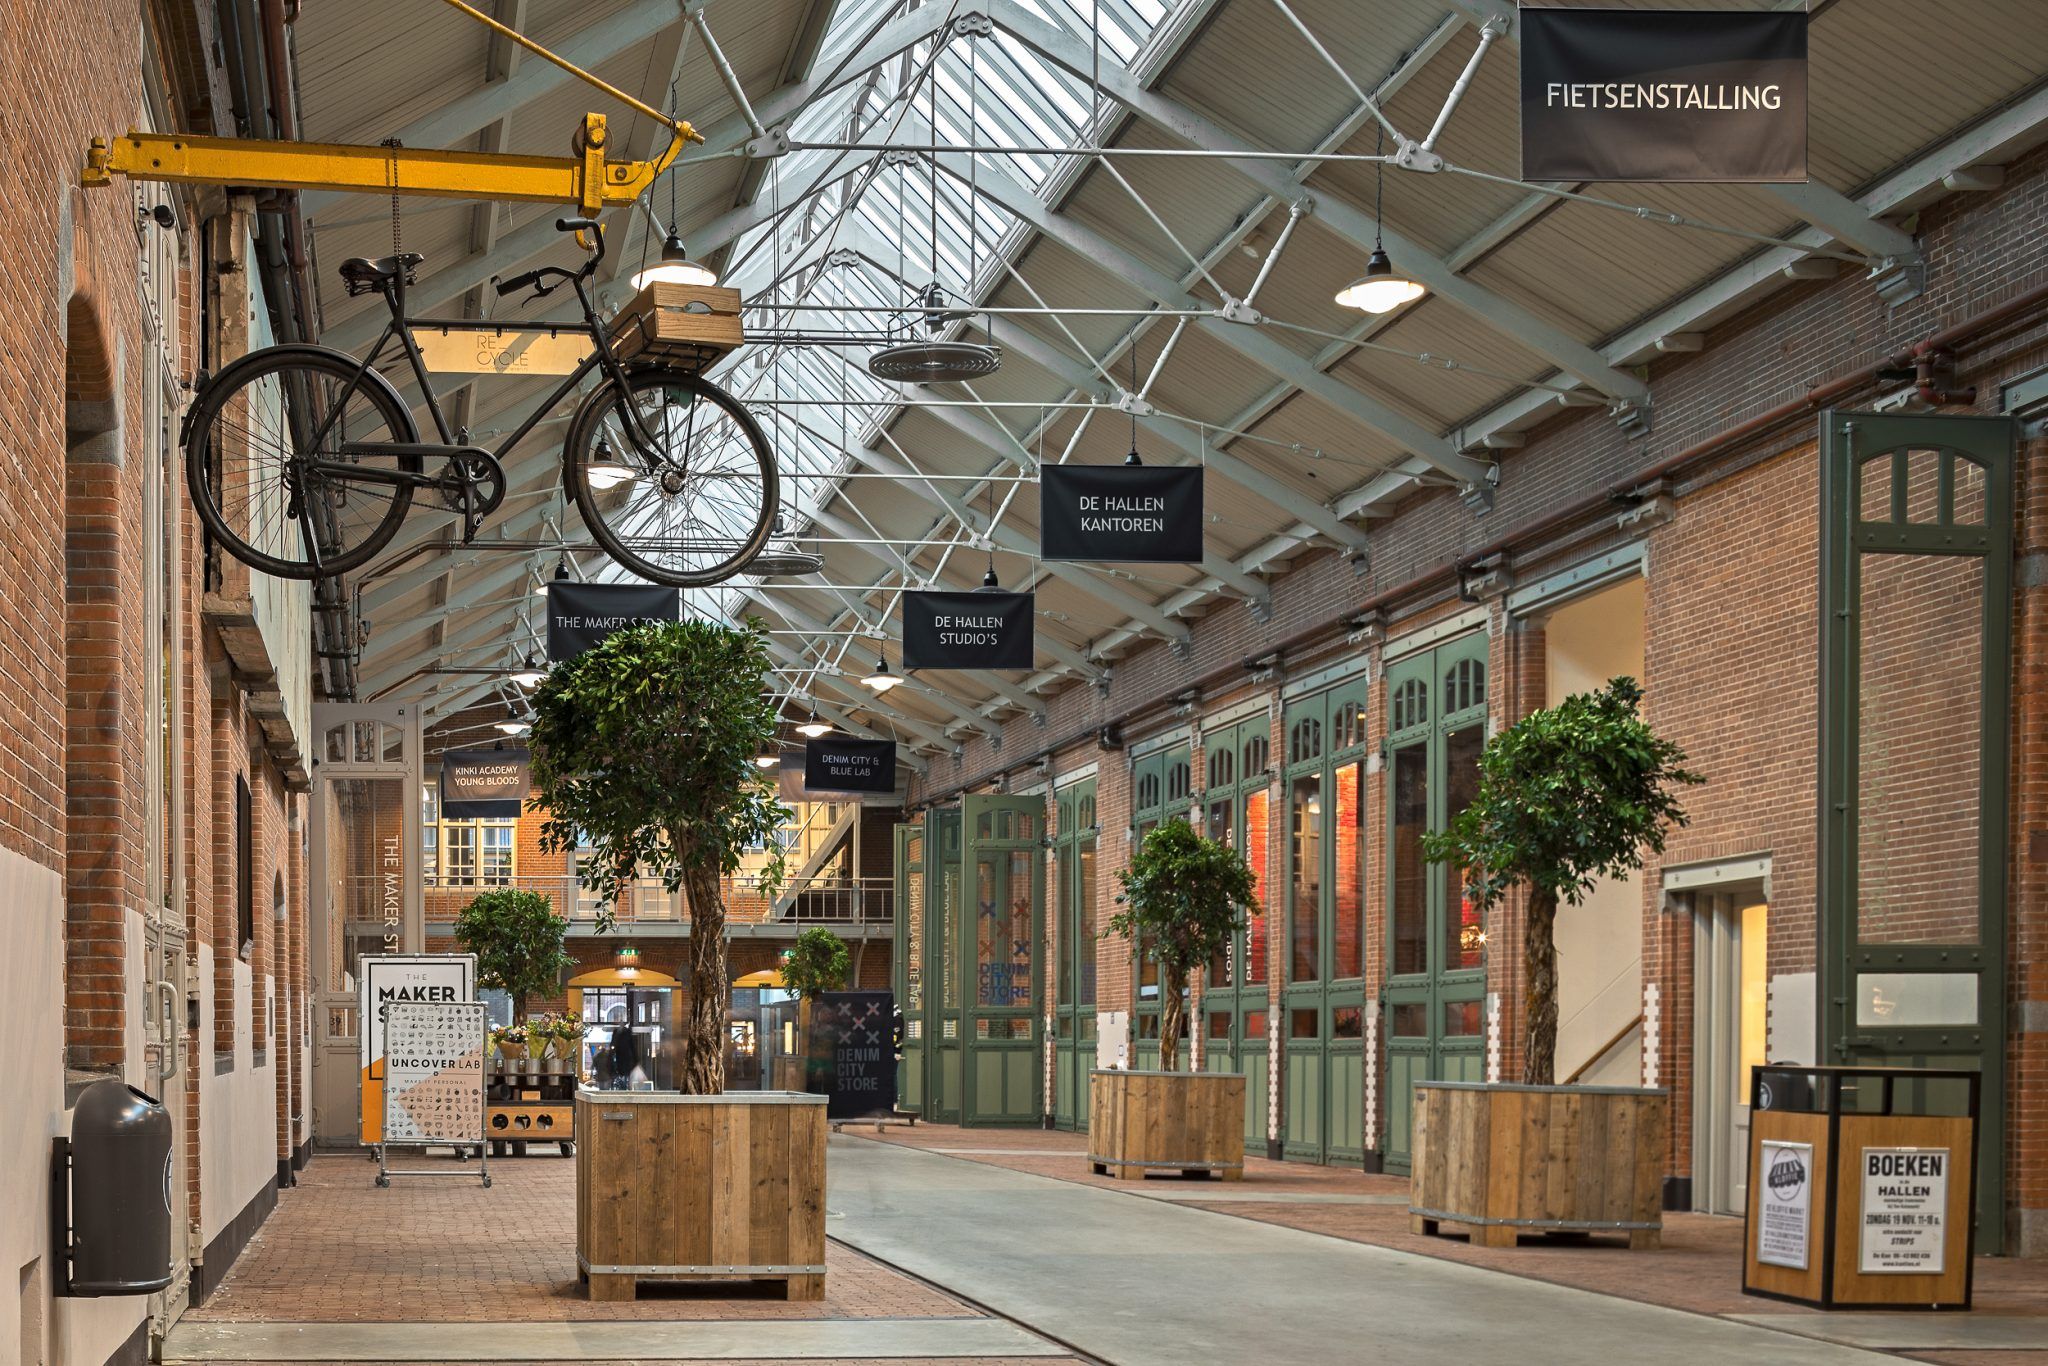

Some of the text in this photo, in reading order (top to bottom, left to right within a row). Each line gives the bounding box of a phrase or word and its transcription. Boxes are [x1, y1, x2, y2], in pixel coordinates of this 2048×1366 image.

[1547, 83, 1781, 110] FIETSENSTALLING
[477, 351, 528, 366] CYCLE
[1080, 496, 1164, 511] DE HALLEN
[1081, 517, 1164, 532] KANTOREN
[556, 616, 581, 628] THE
[585, 617, 627, 629] MAKER
[935, 616, 1003, 629] DE HALLEN
[940, 632, 998, 645] STUDIO'S
[822, 754, 880, 766] DENIM CITY &
[455, 765, 518, 776] KINKI ACADEMY
[830, 766, 871, 777] BLUE LAB
[455, 776, 520, 786] YOUNG BLOODS
[384, 835, 399, 867] THE
[384, 872, 399, 927] MAKER
[979, 963, 1031, 974] DENIM
[1246, 961, 1252, 981] DE
[406, 973, 428, 981] THE
[979, 974, 1012, 986] CITY
[379, 986, 456, 1002] MAKER
[979, 986, 1031, 997] STORE
[837, 1048, 880, 1062] DENIM
[837, 1063, 866, 1076] CITY
[838, 1077, 879, 1091] STORE
[1868, 1155, 1942, 1176] BOEKEN
[1878, 1186, 1930, 1196] HALLEN
[1866, 1214, 1891, 1225] ZONDAG
[1891, 1237, 1915, 1245] STRIPS
